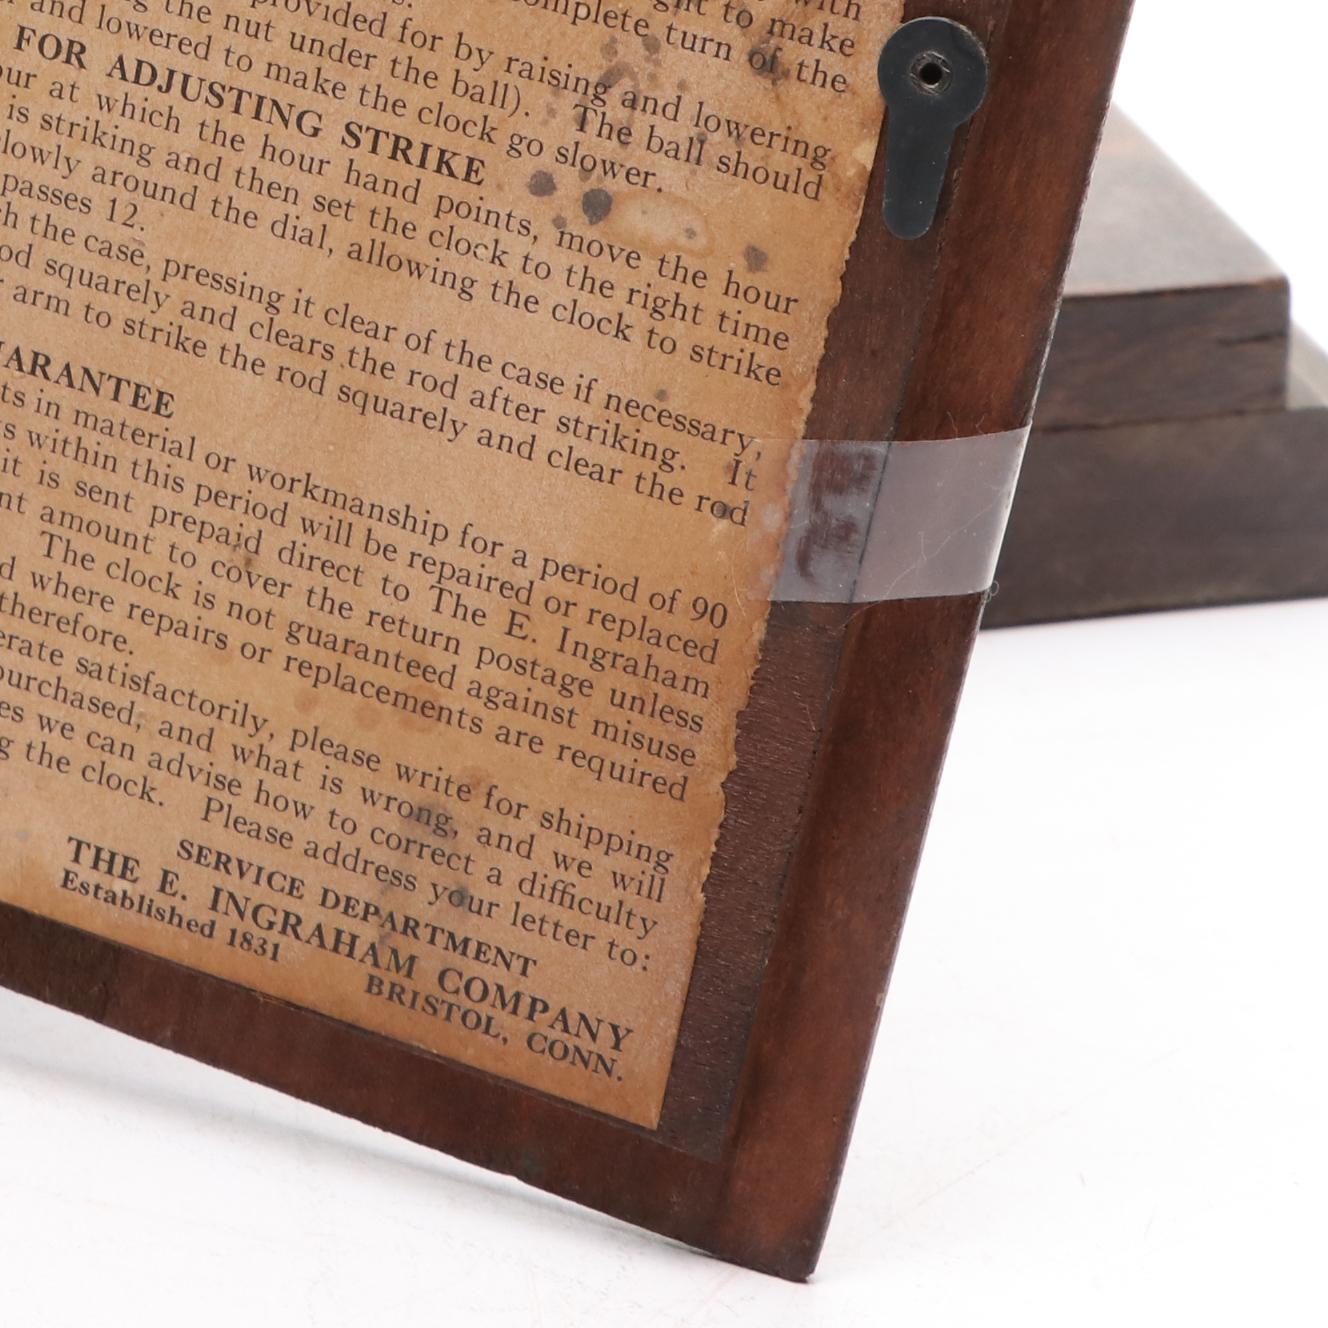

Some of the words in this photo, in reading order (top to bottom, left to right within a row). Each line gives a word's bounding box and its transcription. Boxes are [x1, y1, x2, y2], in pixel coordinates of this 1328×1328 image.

[12, 23, 88, 71] FOR
[104, 53, 323, 139] ADJUSTING
[340, 120, 486, 187] STRIKE
[95, 3, 213, 62] lowered
[223, 44, 253, 73] to
[263, 61, 347, 101] make
[358, 83, 407, 118] the
[416, 100, 499, 145] clock
[505, 132, 544, 160] go
[554, 140, 663, 194] slower.
[0, 172, 92, 215] passes
[105, 196, 145, 232] 12.
[6, 93, 30, 125] is
[39, 112, 157, 169] striking
[164, 151, 223, 184] and
[234, 165, 300, 206] then
[312, 193, 356, 223] set
[368, 205, 417, 241] the
[427, 224, 510, 269] clock
[521, 251, 552, 281] to
[565, 264, 615, 300] the
[625, 281, 704, 326] right
[717, 309, 790, 352] time
[38, 505, 155, 555] amount
[168, 541, 197, 569] to
[210, 559, 293, 599] cover
[305, 585, 354, 620] the
[365, 609, 461, 657] return
[474, 645, 594, 699] postage
[609, 687, 704, 734] unless
[36, 713, 75, 741] we
[85, 730, 135, 762] can
[146, 751, 243, 797] advise
[253, 778, 315, 821] how
[328, 807, 358, 836] to
[369, 826, 475, 876] correct
[485, 866, 503, 887] a
[517, 870, 658, 941] difficulty
[60, 867, 217, 940] Established
[226, 927, 280, 963] 1831
[176, 838, 305, 901] SERVICE
[317, 886, 538, 979] DEPARTMENT
[66, 835, 141, 885] THE
[156, 867, 188, 902] E.
[207, 884, 418, 980] INGRAHAM
[437, 967, 634, 1053] COMPANY
[364, 973, 508, 1046] BRISTOL,
[525, 1031, 623, 1082] CONN.
